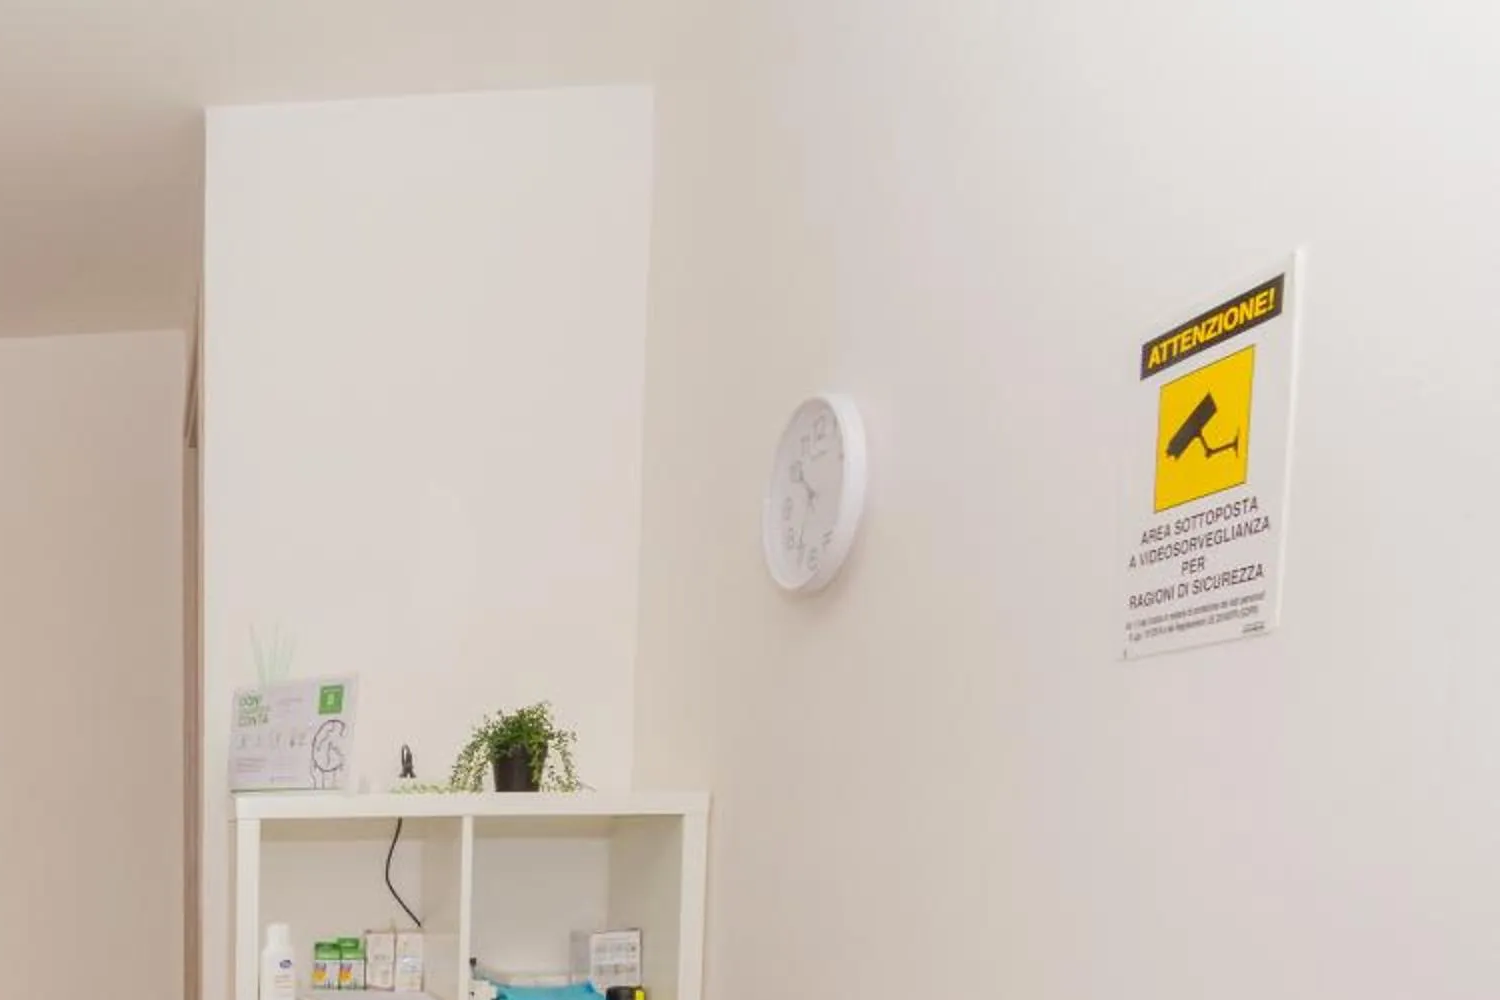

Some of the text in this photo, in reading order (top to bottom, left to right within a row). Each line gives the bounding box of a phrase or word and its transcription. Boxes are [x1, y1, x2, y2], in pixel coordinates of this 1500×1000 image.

[1147, 287, 1276, 369] ATTENZIONE!
[1128, 516, 1271, 569] A VIDEOSORVEGLIANZA
[1141, 496, 1259, 546] AREA SOTTOPOSTA
[1128, 563, 1265, 609] RAGIONI DI SICUREZZA
[1181, 556, 1205, 575] PER
